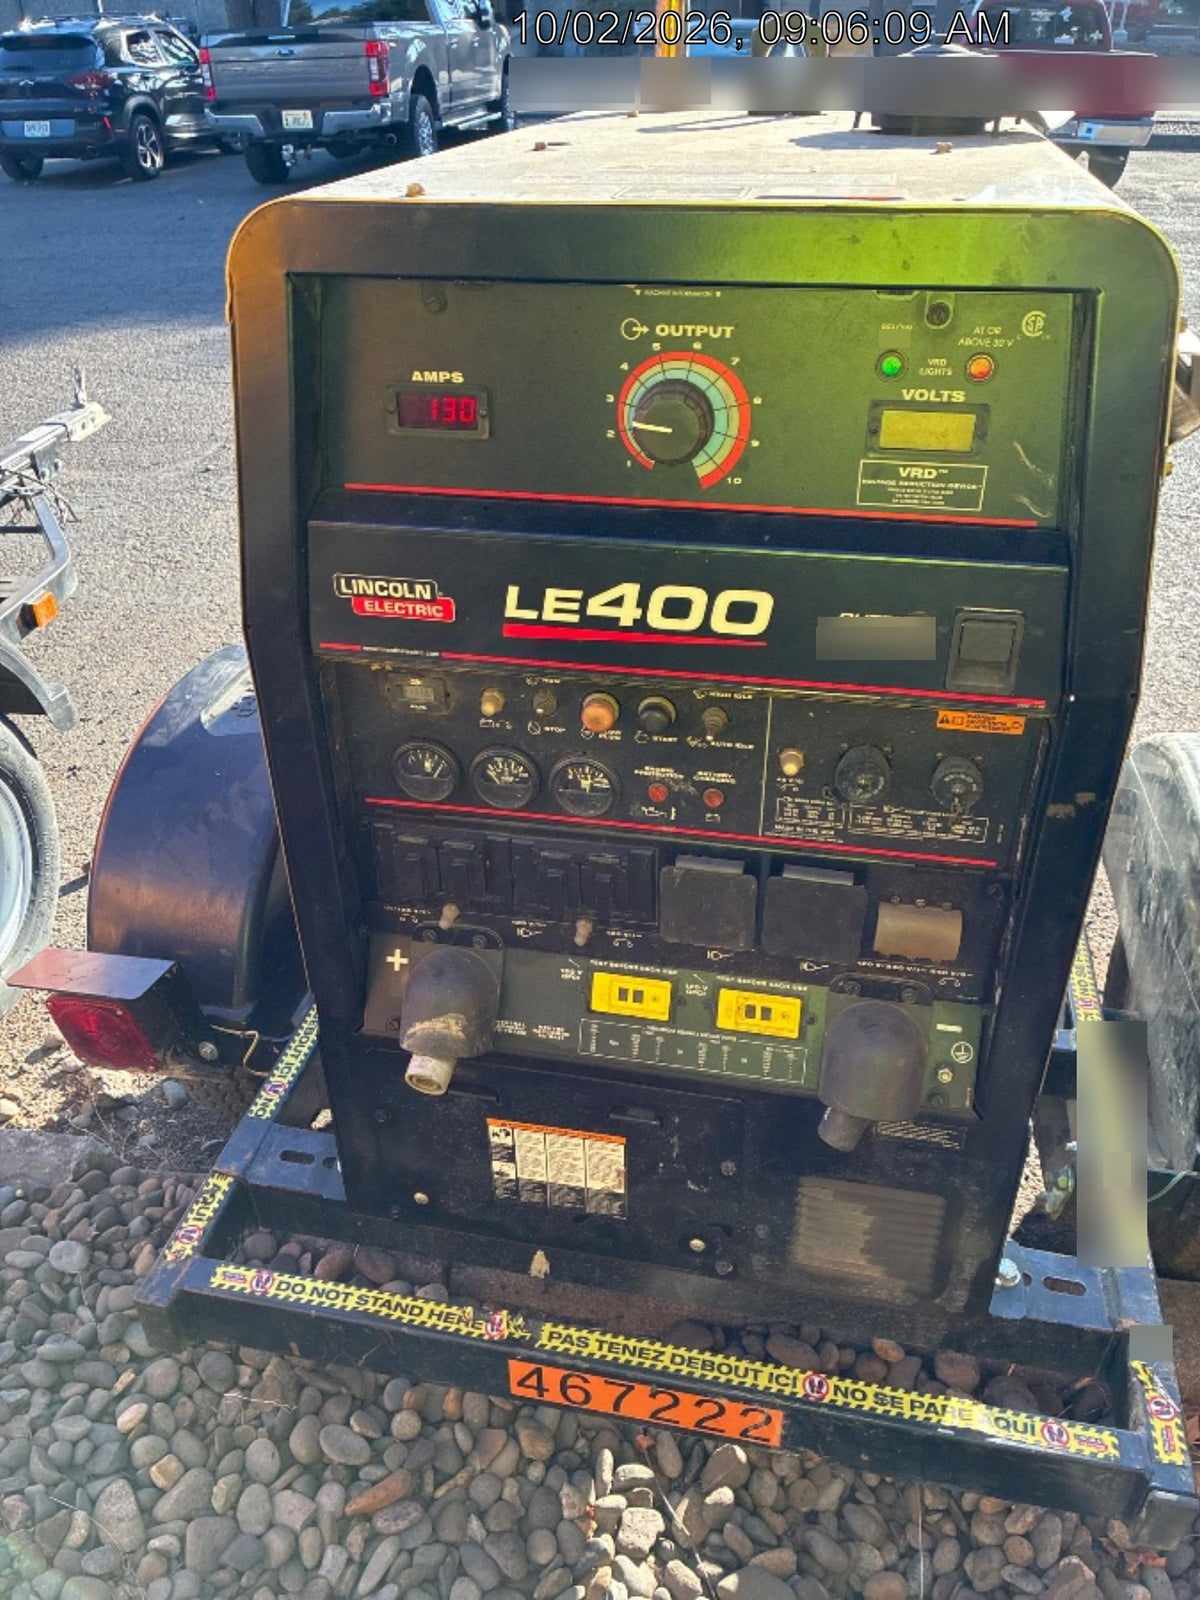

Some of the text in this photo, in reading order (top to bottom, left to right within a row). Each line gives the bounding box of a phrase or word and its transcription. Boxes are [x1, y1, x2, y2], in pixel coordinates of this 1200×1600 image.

[655, 324, 735, 339] OUTPUT
[987, 327, 1003, 335] OR
[652, 342, 661, 351] 5
[693, 341, 703, 351] 6
[958, 338, 991, 347] ABOVE
[619, 362, 629, 371] 4
[732, 357, 740, 366] 7
[928, 358, 947, 367] VRD
[919, 367, 952, 376] LIGHTS
[411, 370, 465, 384] AMPS
[605, 394, 614, 403] 3
[901, 388, 967, 403] VOLTS
[431, 396, 477, 424] 130
[606, 429, 616, 438] 2
[750, 439, 760, 448] 9
[727, 477, 742, 485] 10
[340, 578, 431, 600] LINCOLN
[363, 600, 444, 618] ELECTRIC
[504, 582, 774, 636] LE400
[276, 1280, 484, 1331] DO NOT STAND HERE
[547, 1331, 797, 1388] PAS TENEZ DEBOUT ICI
[833, 1384, 867, 1402] NO
[873, 1391, 904, 1409] SE
[517, 1366, 773, 1442] 467222
